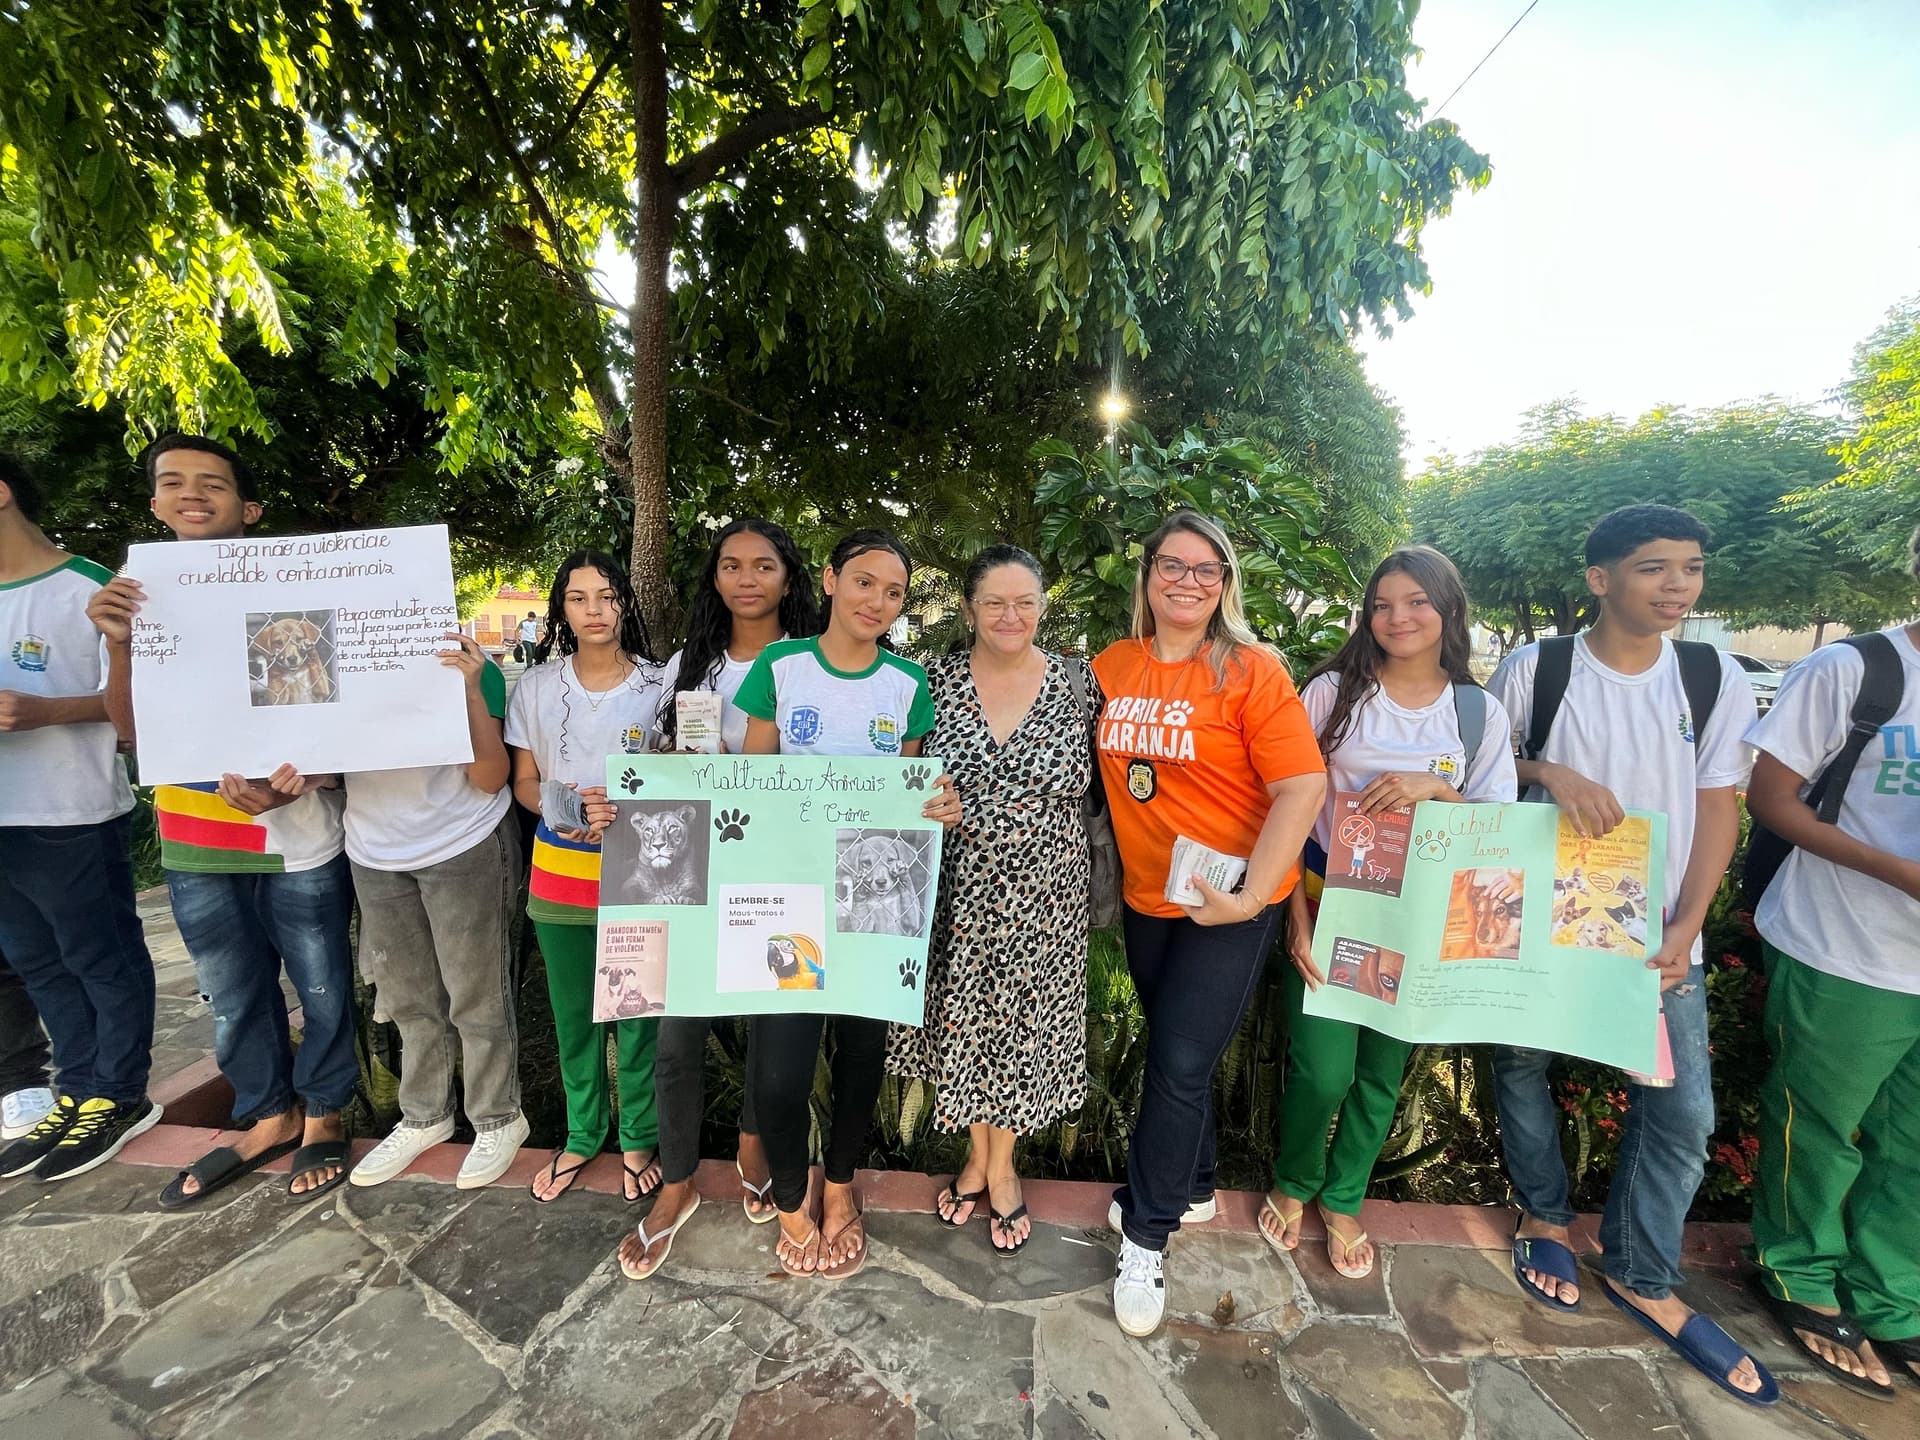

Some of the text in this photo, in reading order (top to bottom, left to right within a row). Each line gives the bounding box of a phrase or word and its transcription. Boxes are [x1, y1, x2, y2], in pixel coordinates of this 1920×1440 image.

[210, 543, 258, 570] Diga
[263, 540, 295, 556] não
[296, 543, 310, 555] a
[178, 559, 394, 586] crueldade contra animais
[338, 597, 455, 622] Para combater esse
[132, 617, 165, 631] Ame
[386, 624, 404, 632] sua
[132, 632, 168, 645] Cuide
[369, 633, 412, 650] qualquer
[337, 649, 349, 660] de
[1104, 696, 1163, 724] ABRIL
[1099, 721, 1196, 761] LARANJA
[692, 760, 886, 792] Maltratar Animais
[729, 897, 785, 905] LEMBRE-SE
[729, 909, 778, 917] Maus-tratos
[607, 925, 663, 935] ABANDONO TAMBÉM
[611, 935, 624, 944] UMA
[625, 935, 645, 944] FORMA
[605, 943, 645, 954] DE VIOLÊNCIA
